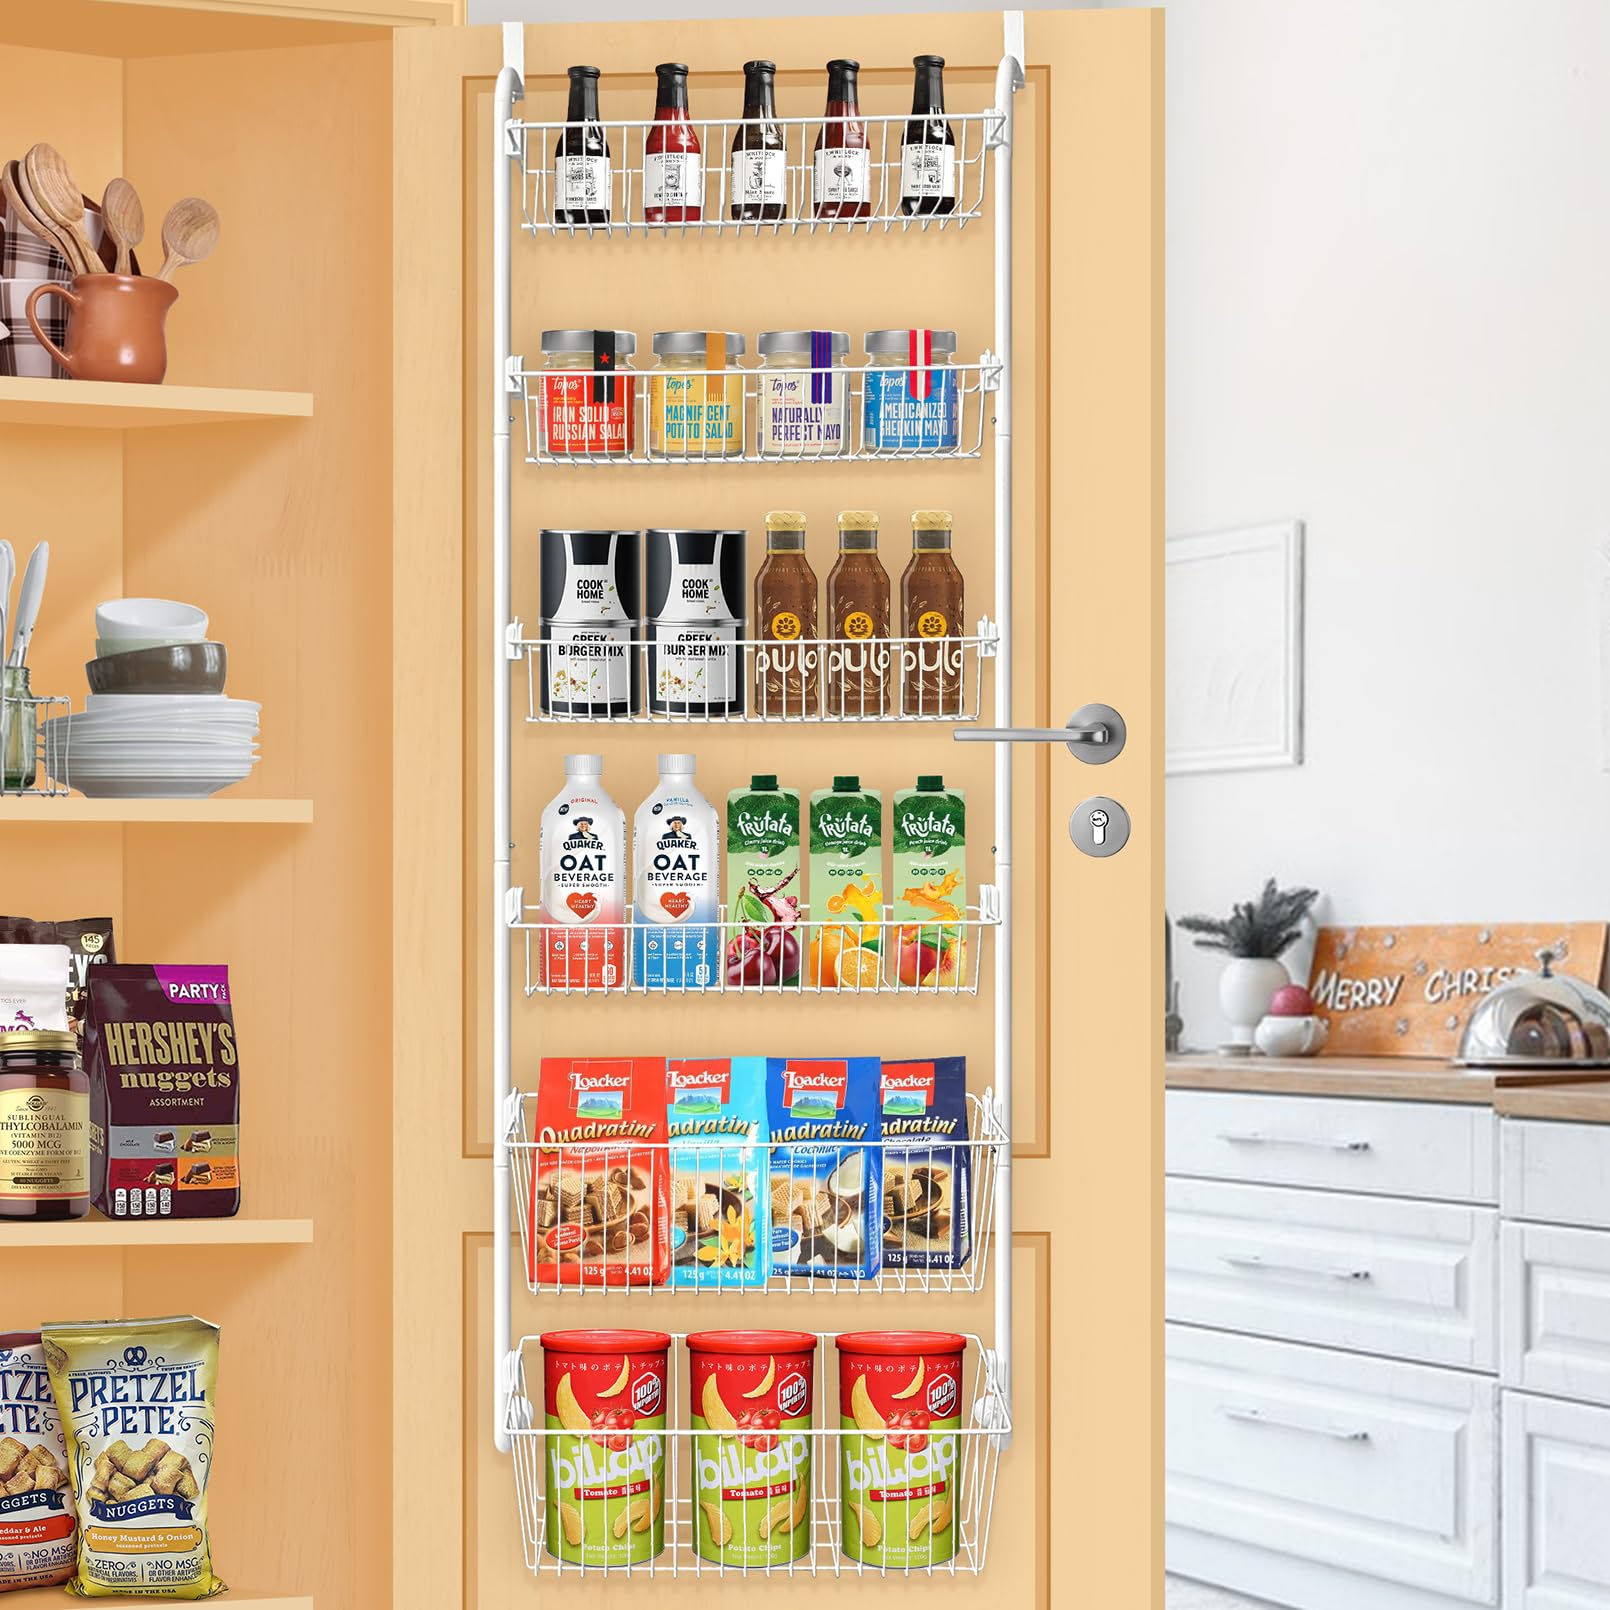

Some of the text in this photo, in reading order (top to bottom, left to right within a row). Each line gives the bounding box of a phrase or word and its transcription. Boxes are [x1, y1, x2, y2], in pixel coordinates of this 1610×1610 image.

[666, 405, 730, 421] MAGNIFCENT
[772, 408, 826, 423] NATURALLY
[553, 424, 596, 440] RUSSIAN
[706, 422, 733, 438] SALD
[925, 420, 948, 436] MAYO
[577, 580, 604, 589] COOK
[682, 579, 708, 589] COOK
[577, 590, 604, 599] HOME
[682, 589, 709, 599] HOME
[559, 645, 624, 657] BURGER MIX
[664, 645, 706, 656] BURGER
[563, 840, 604, 851] QUAKER
[656, 840, 697, 850] QUAKER
[560, 854, 607, 871] OAT
[653, 854, 700, 871] OAT
[554, 873, 614, 882] BEVERAGE
[647, 872, 708, 881] BEVERAGE
[84, 935, 100, 944] 145
[169, 983, 219, 998] PARTY
[1311, 967, 1516, 1011] MERRY CHRIS
[104, 1022, 236, 1066] HERSHEY'S
[120, 1067, 232, 1093] nuggets
[569, 1073, 631, 1090] Loacker
[666, 1071, 729, 1087] Loacker
[781, 1070, 846, 1088] Loacker
[149, 1097, 205, 1107] ASSORTMENT
[540, 1120, 657, 1154] Quadratini
[12, 1140, 61, 1149] 5000 MCG
[888, 1254, 901, 1262] 125
[584, 1267, 598, 1275] 125
[683, 1270, 697, 1278] 125
[68, 1369, 206, 1413] PRETZEL
[1, 1492, 47, 1509] GGETS
[106, 1498, 175, 1518] NUGGETS
[33, 1525, 47, 1533] Ale
[91, 1533, 118, 1543] Honey
[119, 1533, 156, 1542] Mustard
[166, 1533, 194, 1541] Onion
[32, 1543, 73, 1559] NO MSG
[27, 1563, 48, 1571] FLAVOR
[34, 1556, 52, 1565] OTHER
[94, 1557, 199, 1571] ZERO NO MSG
